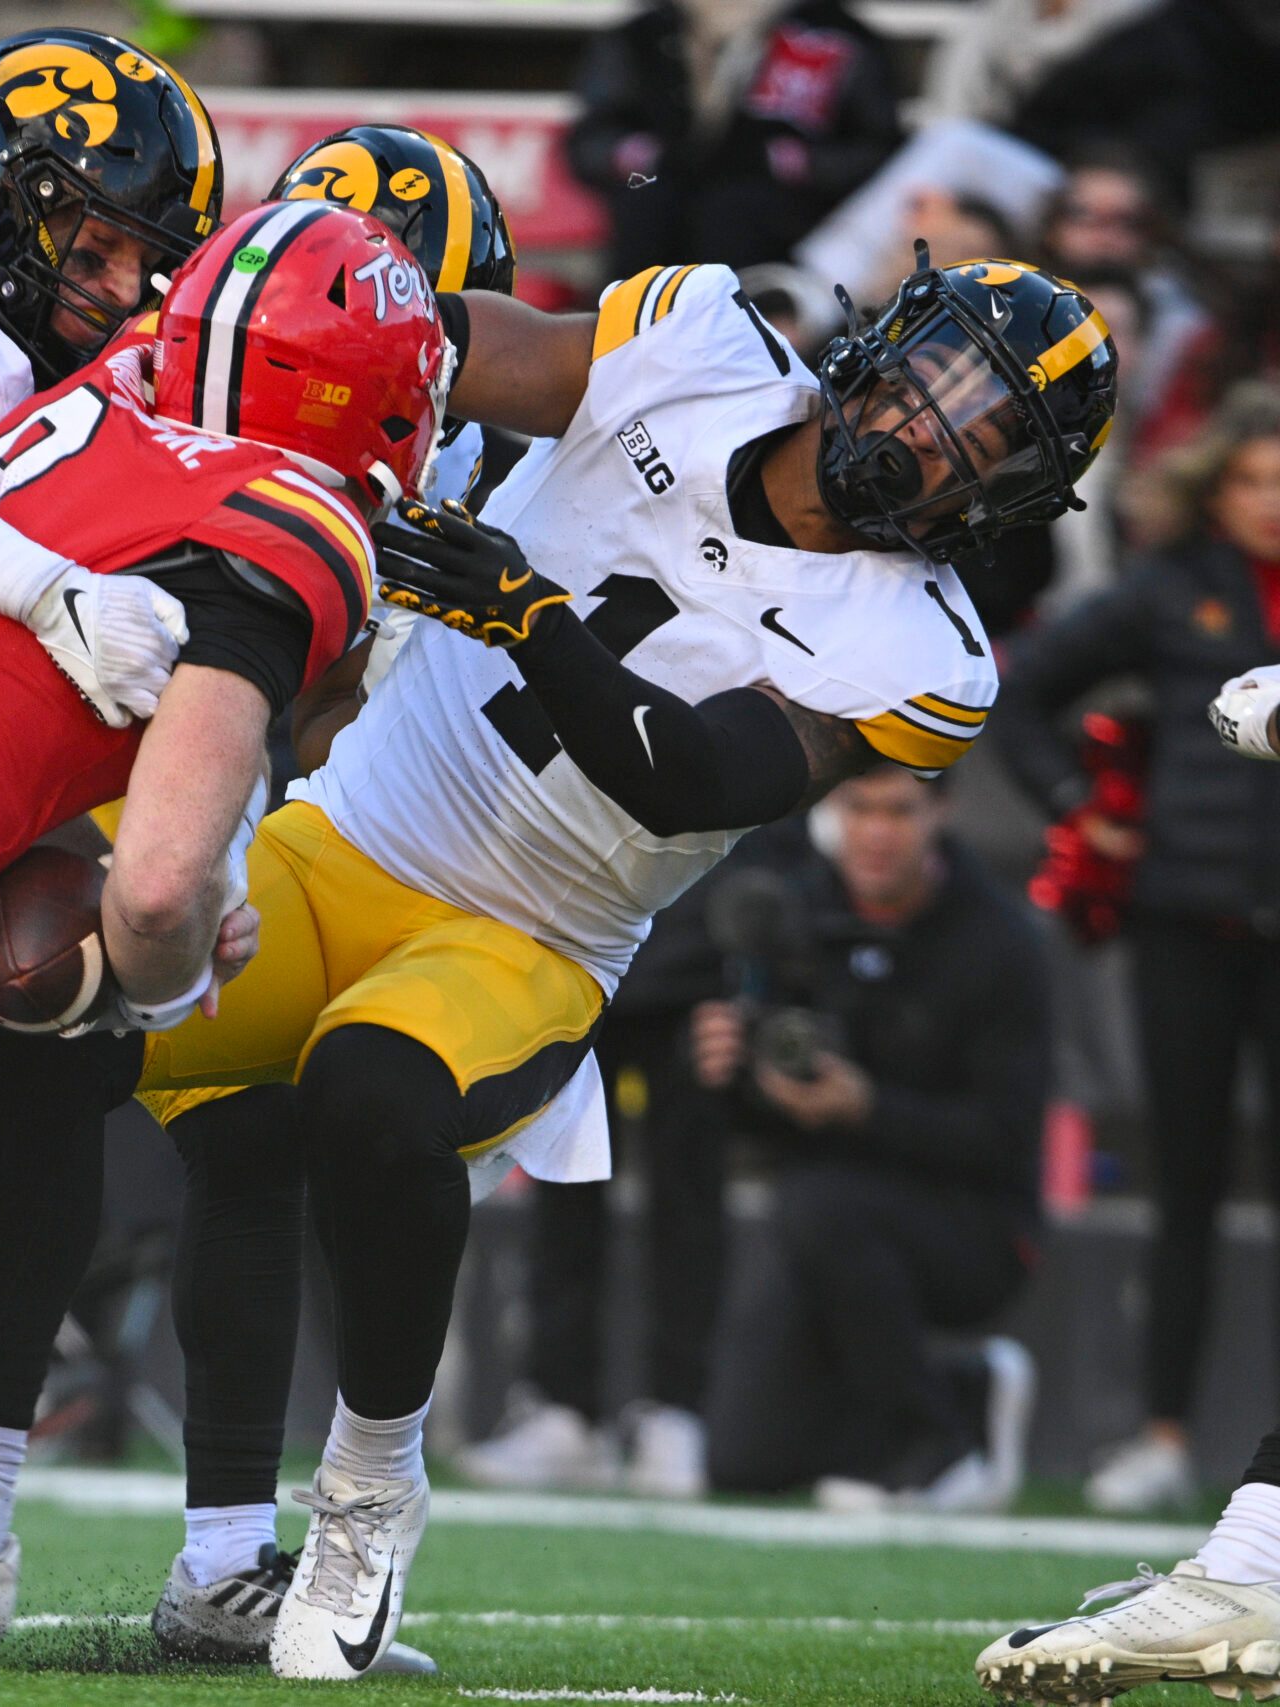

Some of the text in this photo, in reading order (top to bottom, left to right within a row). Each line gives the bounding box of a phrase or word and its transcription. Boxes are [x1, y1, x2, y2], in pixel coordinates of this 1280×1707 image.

[238, 251, 265, 265] C2P
[731, 288, 792, 378] 1
[923, 580, 986, 658] 1
